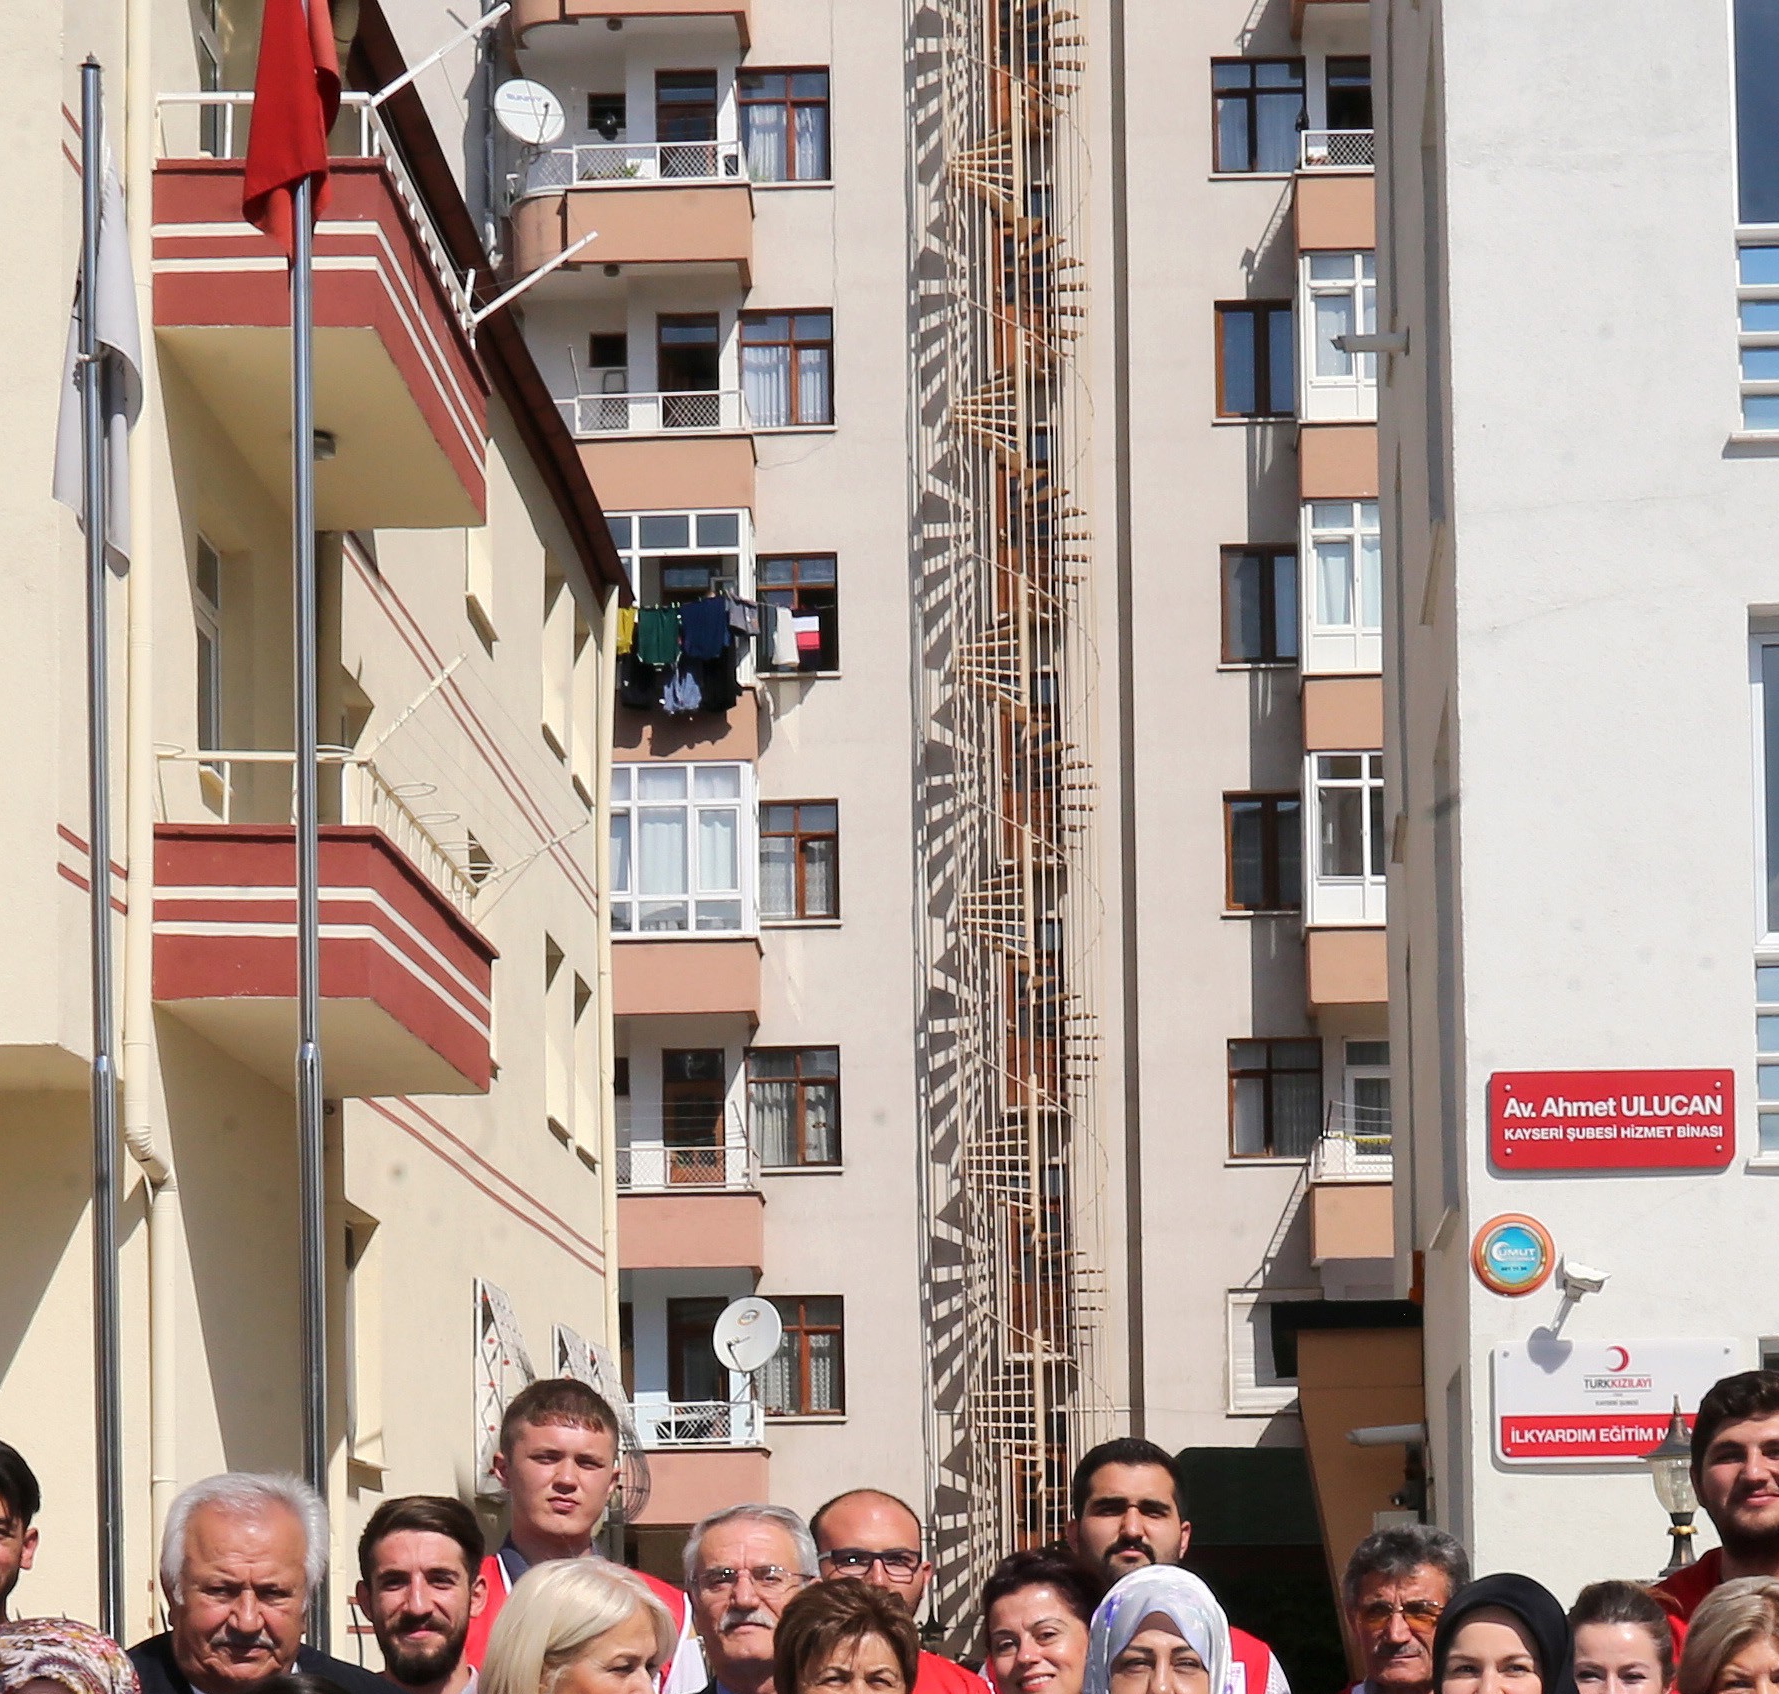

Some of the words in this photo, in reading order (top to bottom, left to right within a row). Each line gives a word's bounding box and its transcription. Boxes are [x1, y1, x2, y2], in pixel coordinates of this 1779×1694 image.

[1503, 1097, 1537, 1118] Av.
[1541, 1096, 1617, 1118] Ahmet
[1621, 1095, 1723, 1117] ULUCAN
[1504, 1125, 1563, 1140] KAYSERİ
[1566, 1124, 1617, 1142] ŞUBESİ
[1621, 1123, 1674, 1138] HİZMET
[1677, 1123, 1723, 1138] BİNASI
[1510, 1426, 1596, 1443] İLKYARDIM
[1600, 1424, 1654, 1442] EĞİTİM
